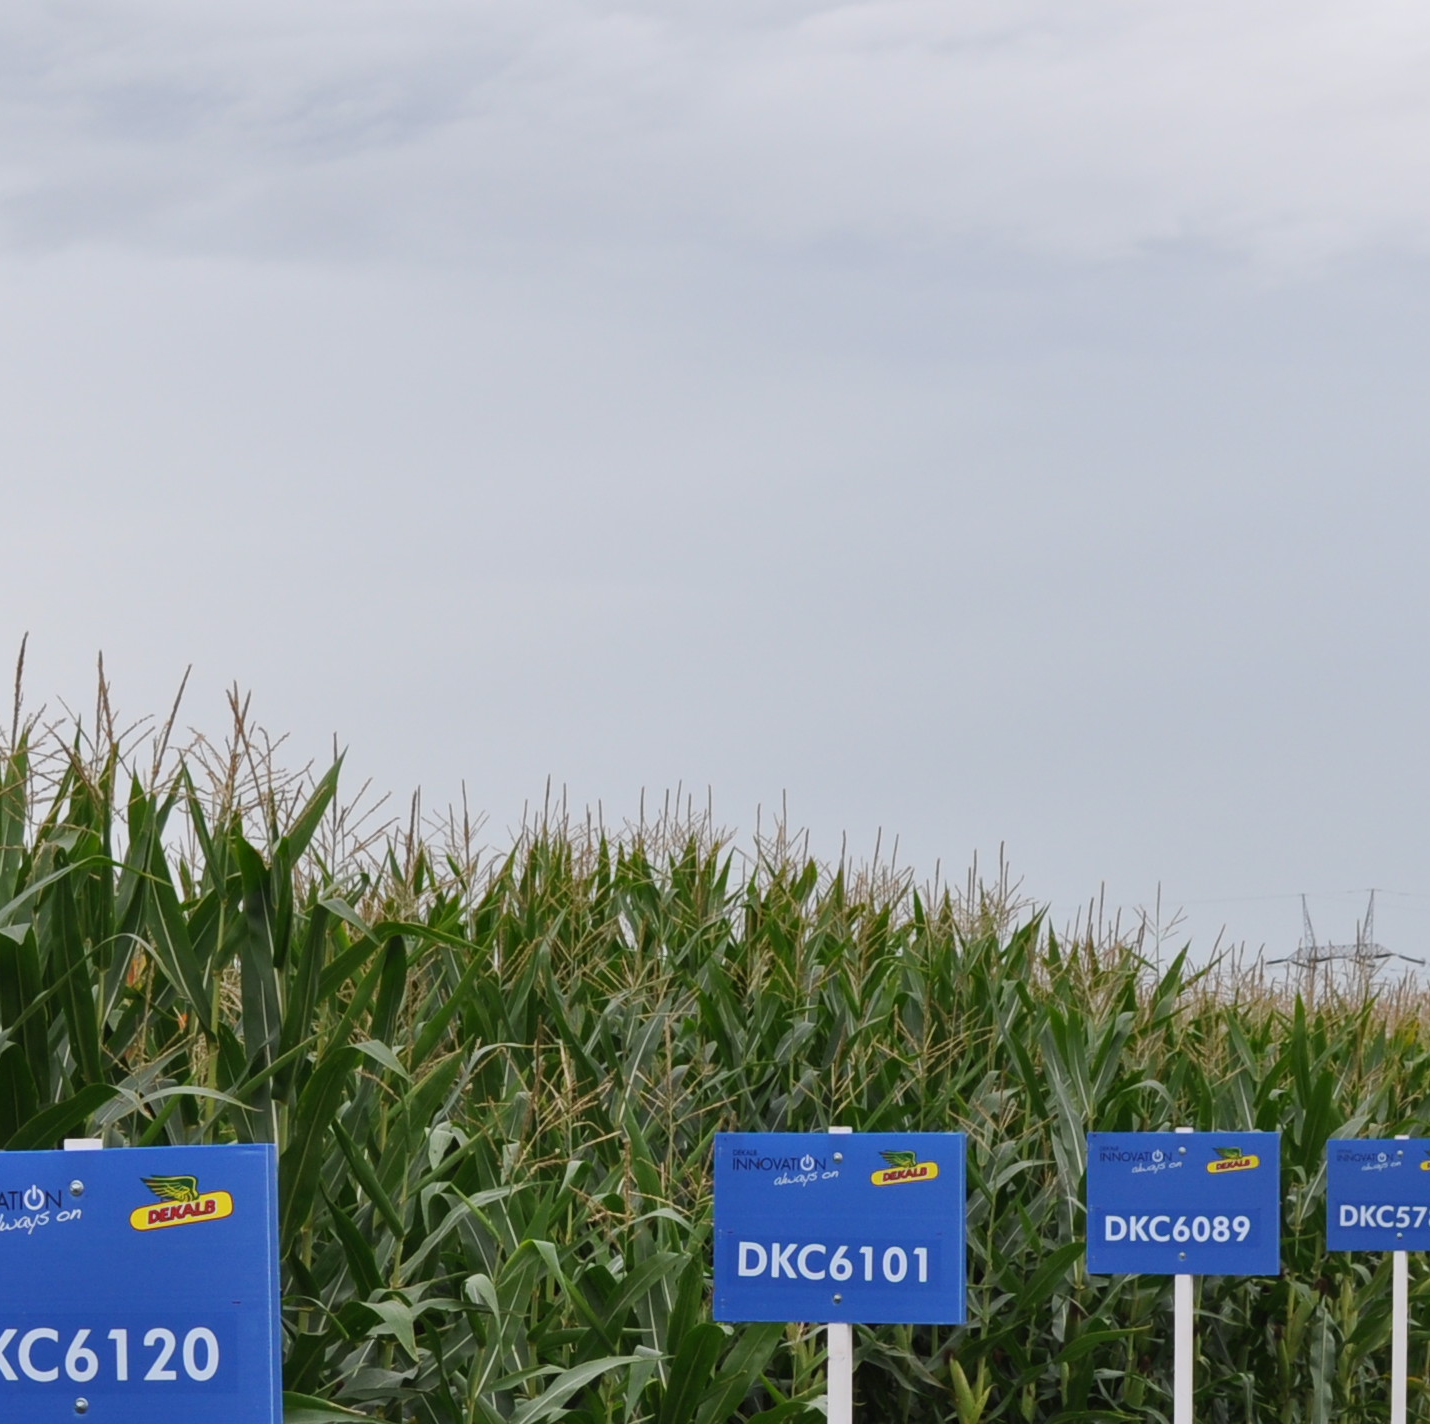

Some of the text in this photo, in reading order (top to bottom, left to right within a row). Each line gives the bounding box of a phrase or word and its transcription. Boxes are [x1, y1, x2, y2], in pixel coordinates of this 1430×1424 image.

[732, 1154, 827, 1171] INNOVATION
[774, 1170, 839, 1187] always on
[883, 1167, 927, 1182] DEKALB
[56, 1209, 82, 1222] on
[148, 1199, 216, 1225] DEKALB
[1105, 1215, 1250, 1242] DKC6089
[738, 1241, 927, 1283] DKC6101
